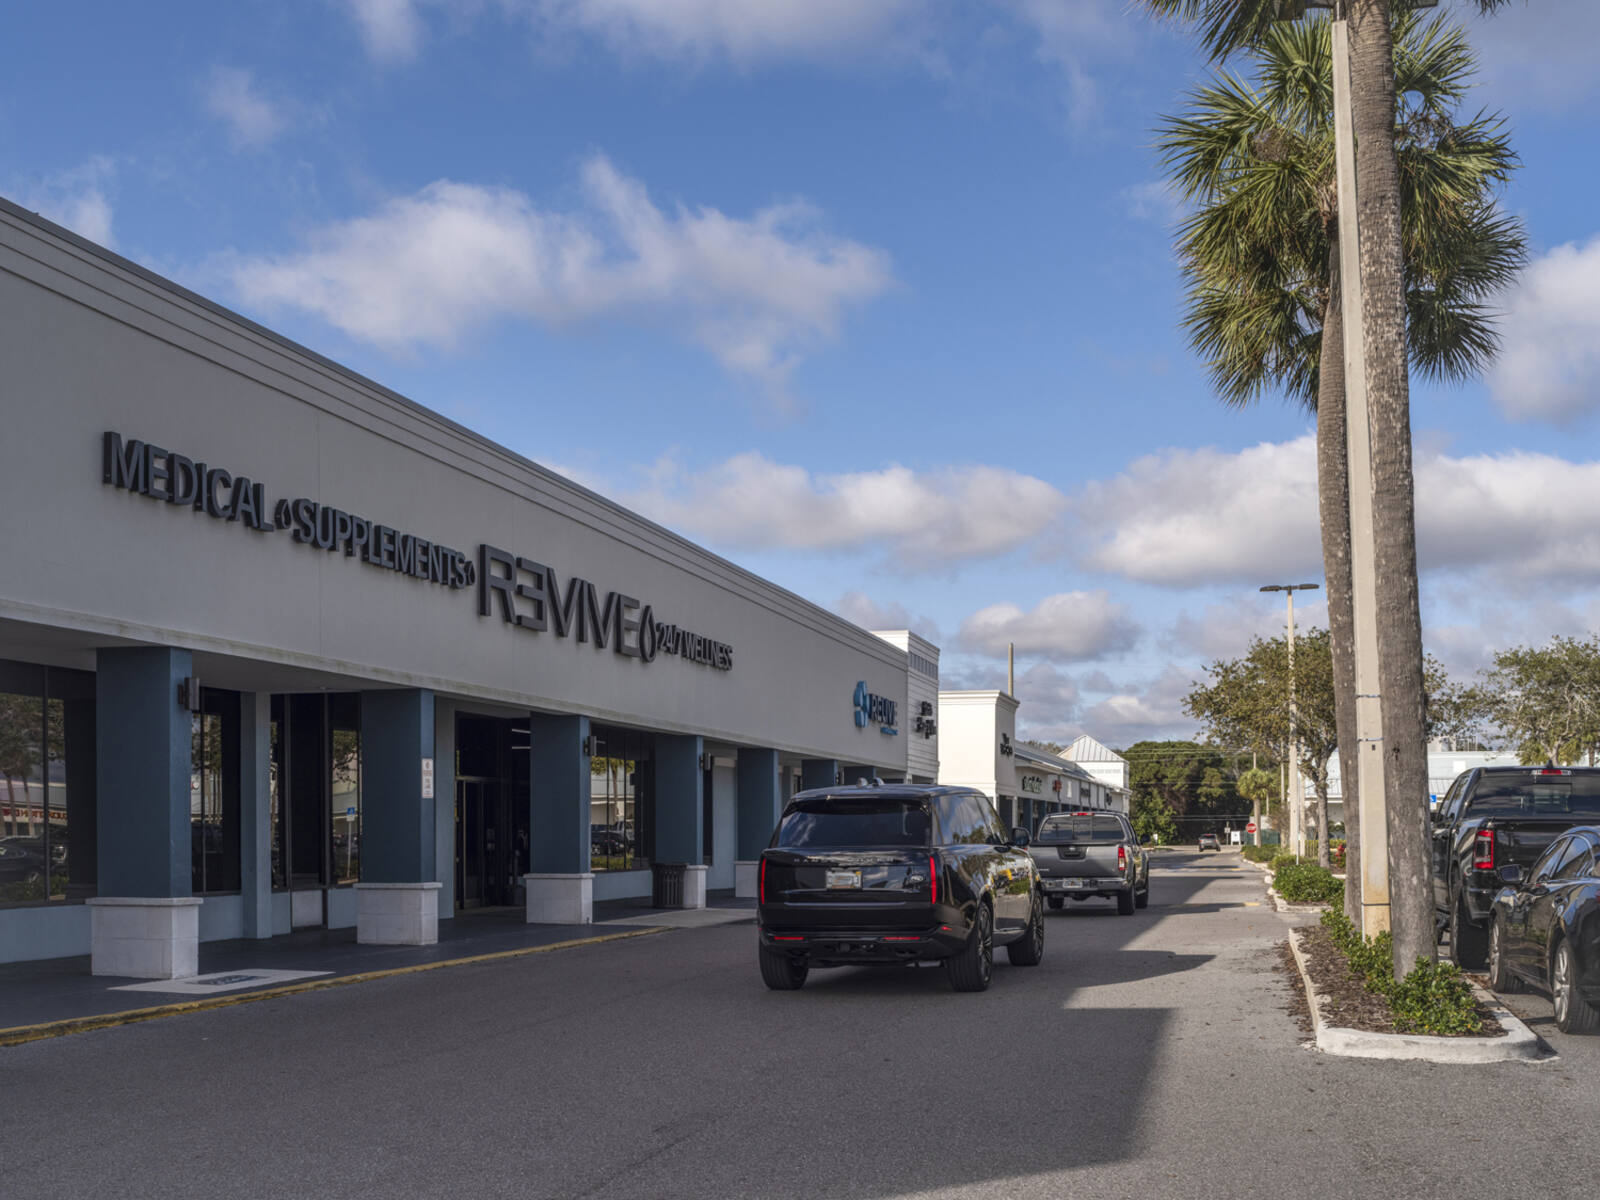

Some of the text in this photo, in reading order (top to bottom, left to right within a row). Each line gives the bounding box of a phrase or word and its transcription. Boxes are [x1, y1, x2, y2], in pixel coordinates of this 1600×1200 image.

[103, 431, 733, 671] MEDICAL SUPPLEMENTS REVIVE 24/7 WELLNESS
